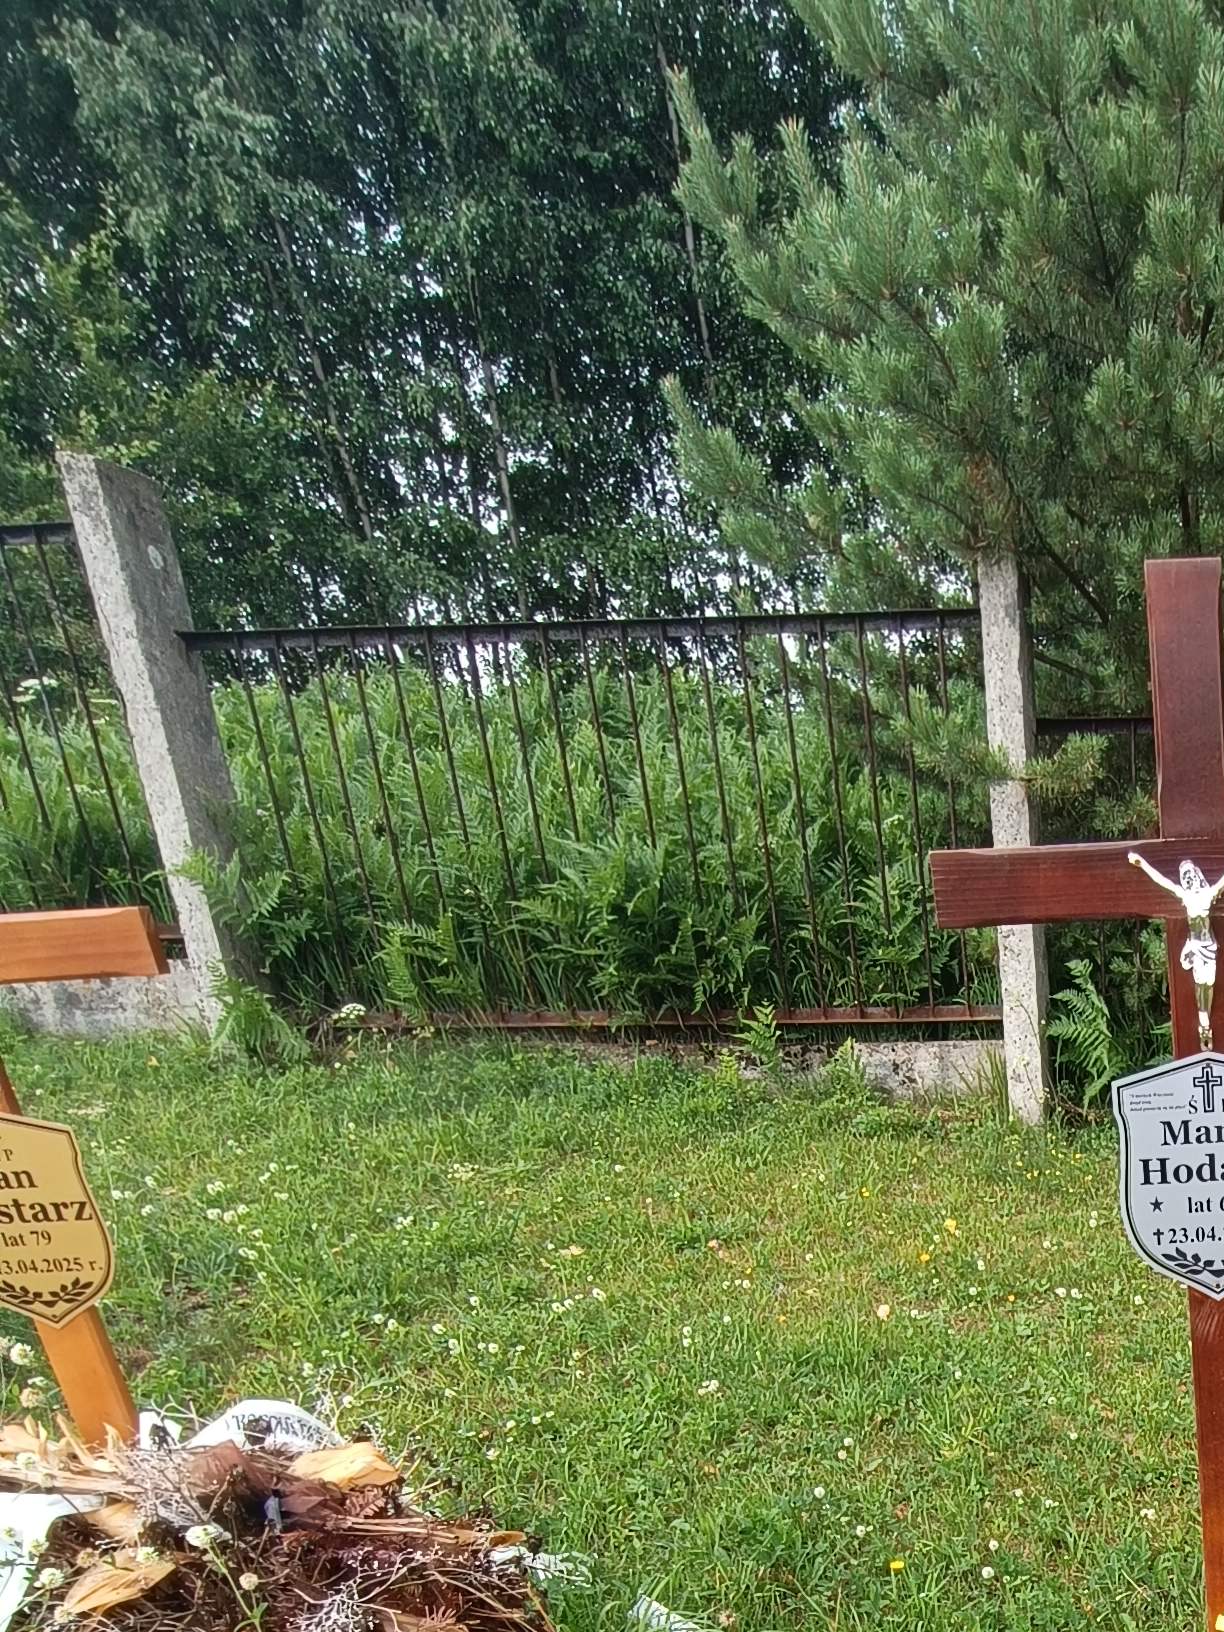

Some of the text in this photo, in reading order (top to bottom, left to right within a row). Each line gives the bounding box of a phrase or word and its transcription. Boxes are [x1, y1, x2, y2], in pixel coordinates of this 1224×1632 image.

[1188, 1094, 1198, 1115] Ś
[1187, 1196, 1212, 1213] lat
[0, 1230, 52, 1247] lat 79
[0, 1257, 84, 1275] 3.04.2025
